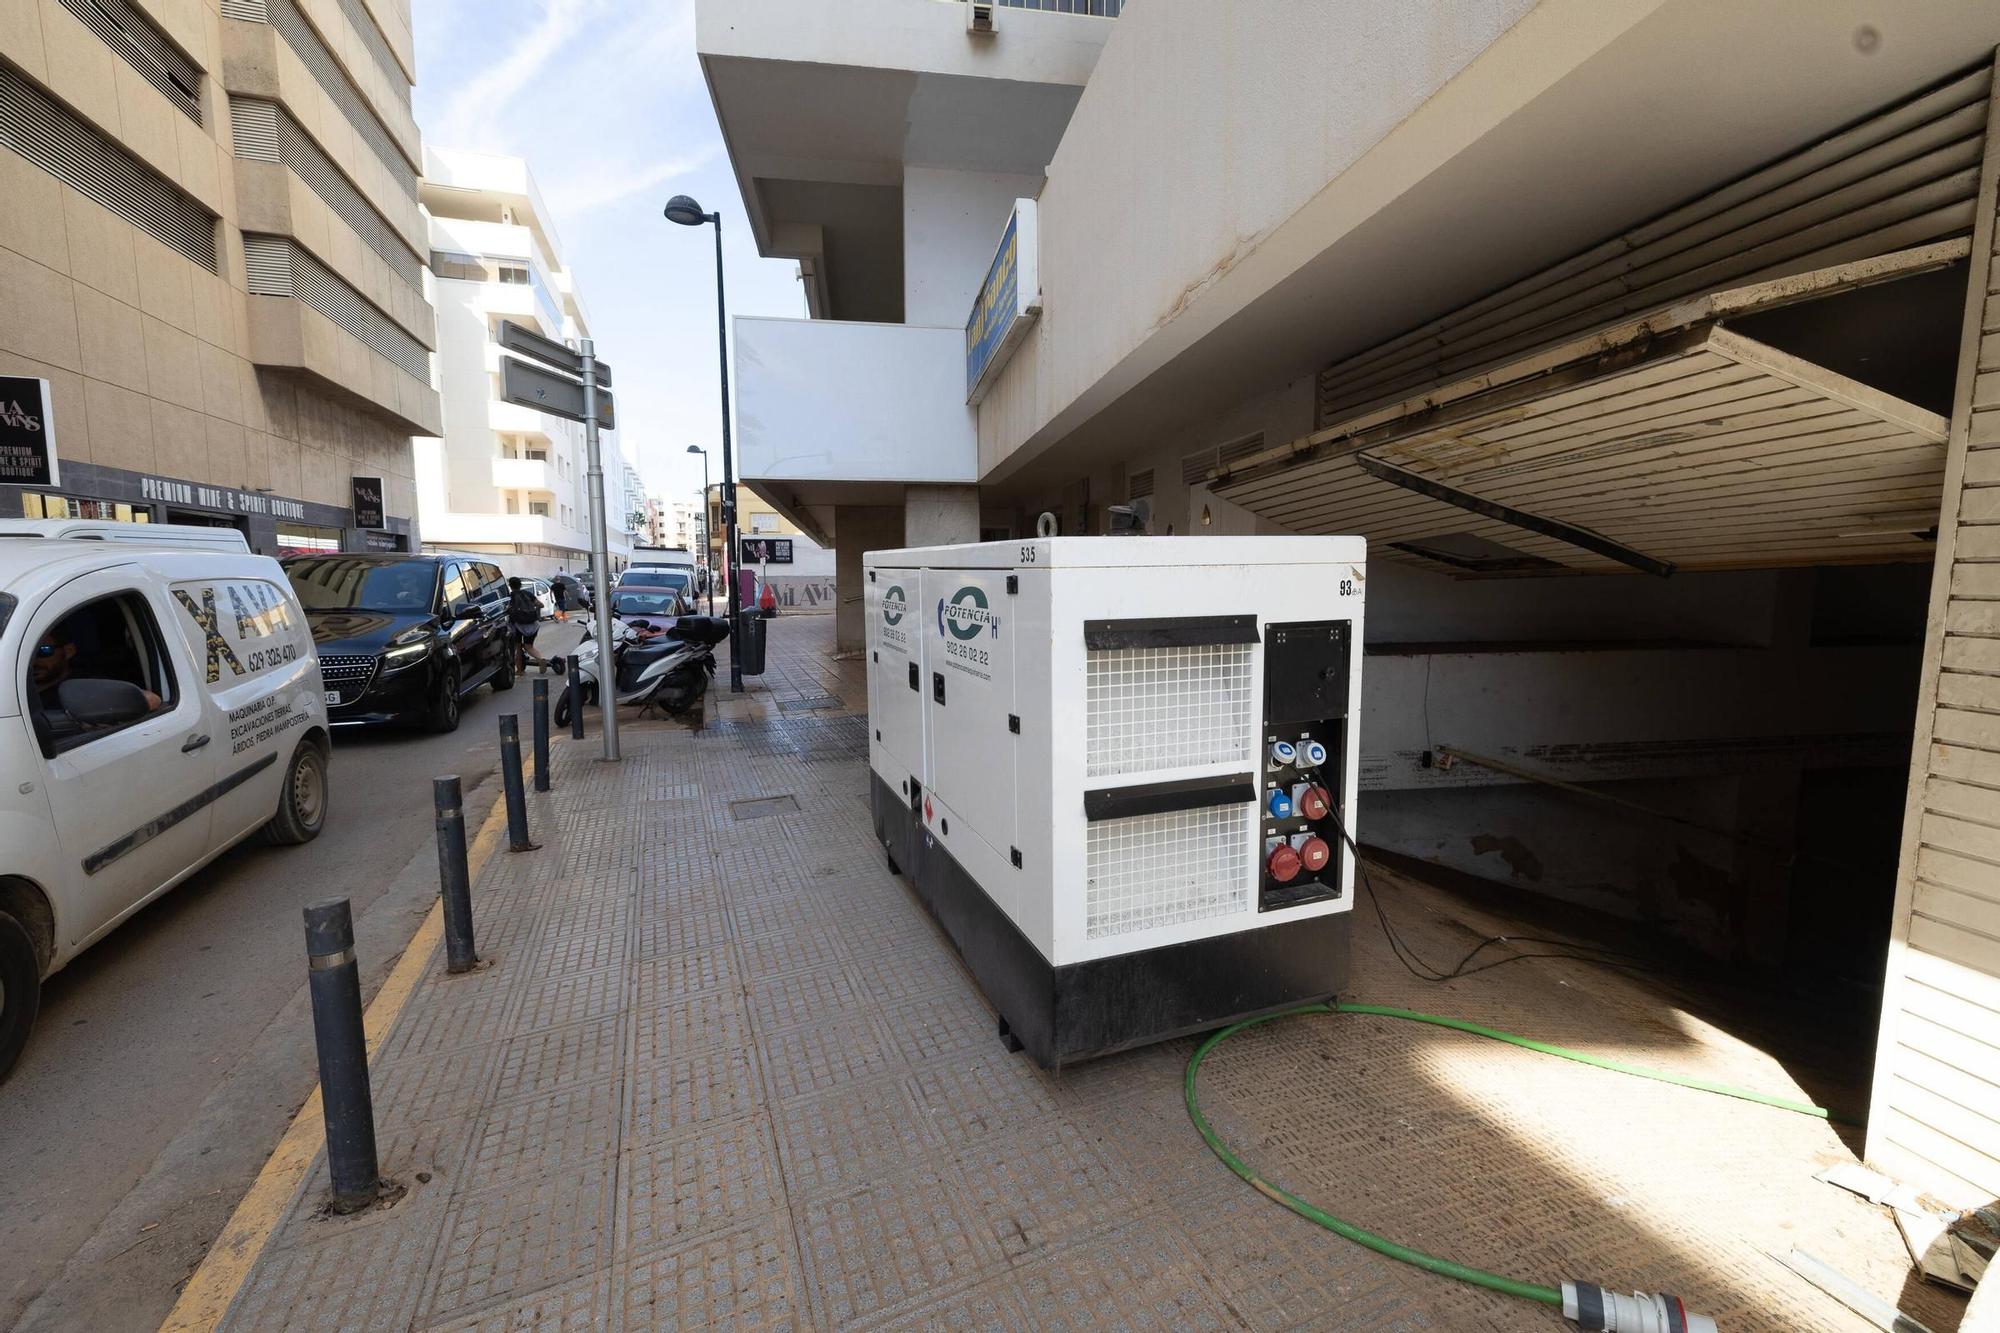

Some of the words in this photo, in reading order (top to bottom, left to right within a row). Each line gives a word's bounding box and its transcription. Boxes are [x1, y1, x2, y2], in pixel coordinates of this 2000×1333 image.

[0, 446, 33, 457] PREMIUM
[20, 457, 42, 468] SPIRIT
[141, 478, 192, 504] PREMIUM
[198, 487, 221, 508] WINE
[227, 491, 234, 510] &
[239, 494, 266, 514] SPIRIT
[271, 499, 304, 520] BOUTIQUE
[1020, 546, 1036, 563] 535
[1339, 580, 1352, 596] 93
[882, 600, 907, 612] POTENCIA
[944, 605, 990, 624] POTENCIA
[248, 651, 265, 672] 629
[265, 647, 282, 667] 325
[283, 643, 297, 661] 470
[946, 641, 957, 655] 902
[959, 645, 967, 658] 26
[969, 647, 977, 662] 02
[979, 651, 989, 666] 22
[229, 700, 266, 723] MAQUINARIA
[230, 711, 275, 740] EXCAVACIONES
[256, 728, 274, 744] PIEDRA
